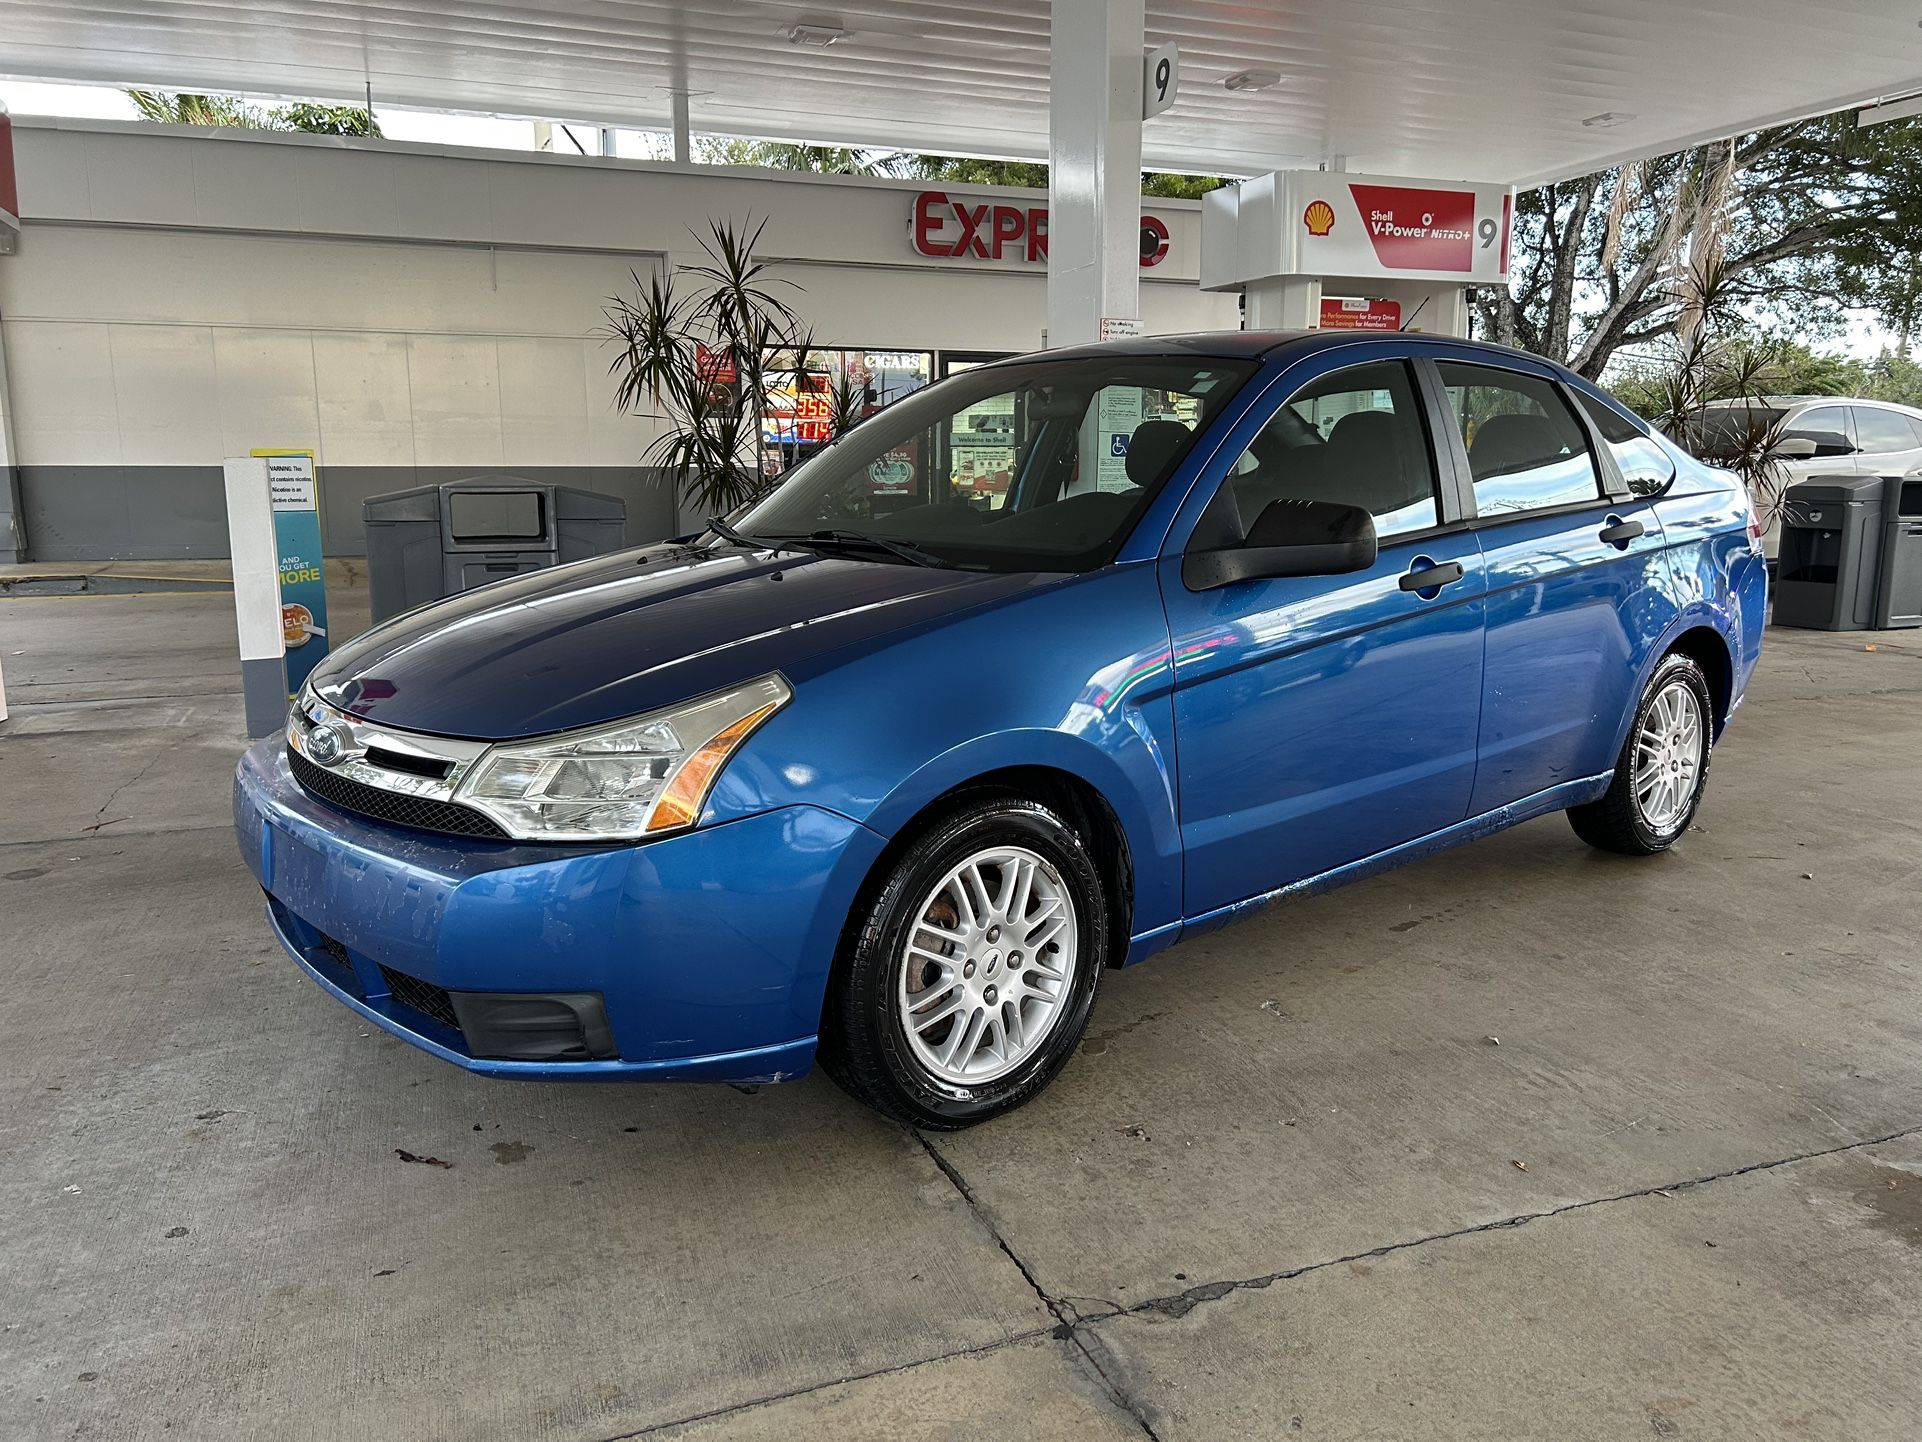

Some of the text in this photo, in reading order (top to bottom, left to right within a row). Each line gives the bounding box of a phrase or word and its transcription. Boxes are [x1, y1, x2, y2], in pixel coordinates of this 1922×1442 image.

[1155, 57, 1170, 102] 9
[1371, 210, 1393, 221] Shell
[1371, 221, 1427, 238] V-Power
[1477, 218, 1498, 249] 9
[1328, 312, 1359, 320] Performance
[1335, 320, 1355, 328] Savings
[864, 355, 920, 369] CIGARS
[279, 561, 310, 571] OU GET
[282, 556, 300, 564] AND
[284, 614, 309, 628] ELO
[310, 737, 332, 755] Ford
